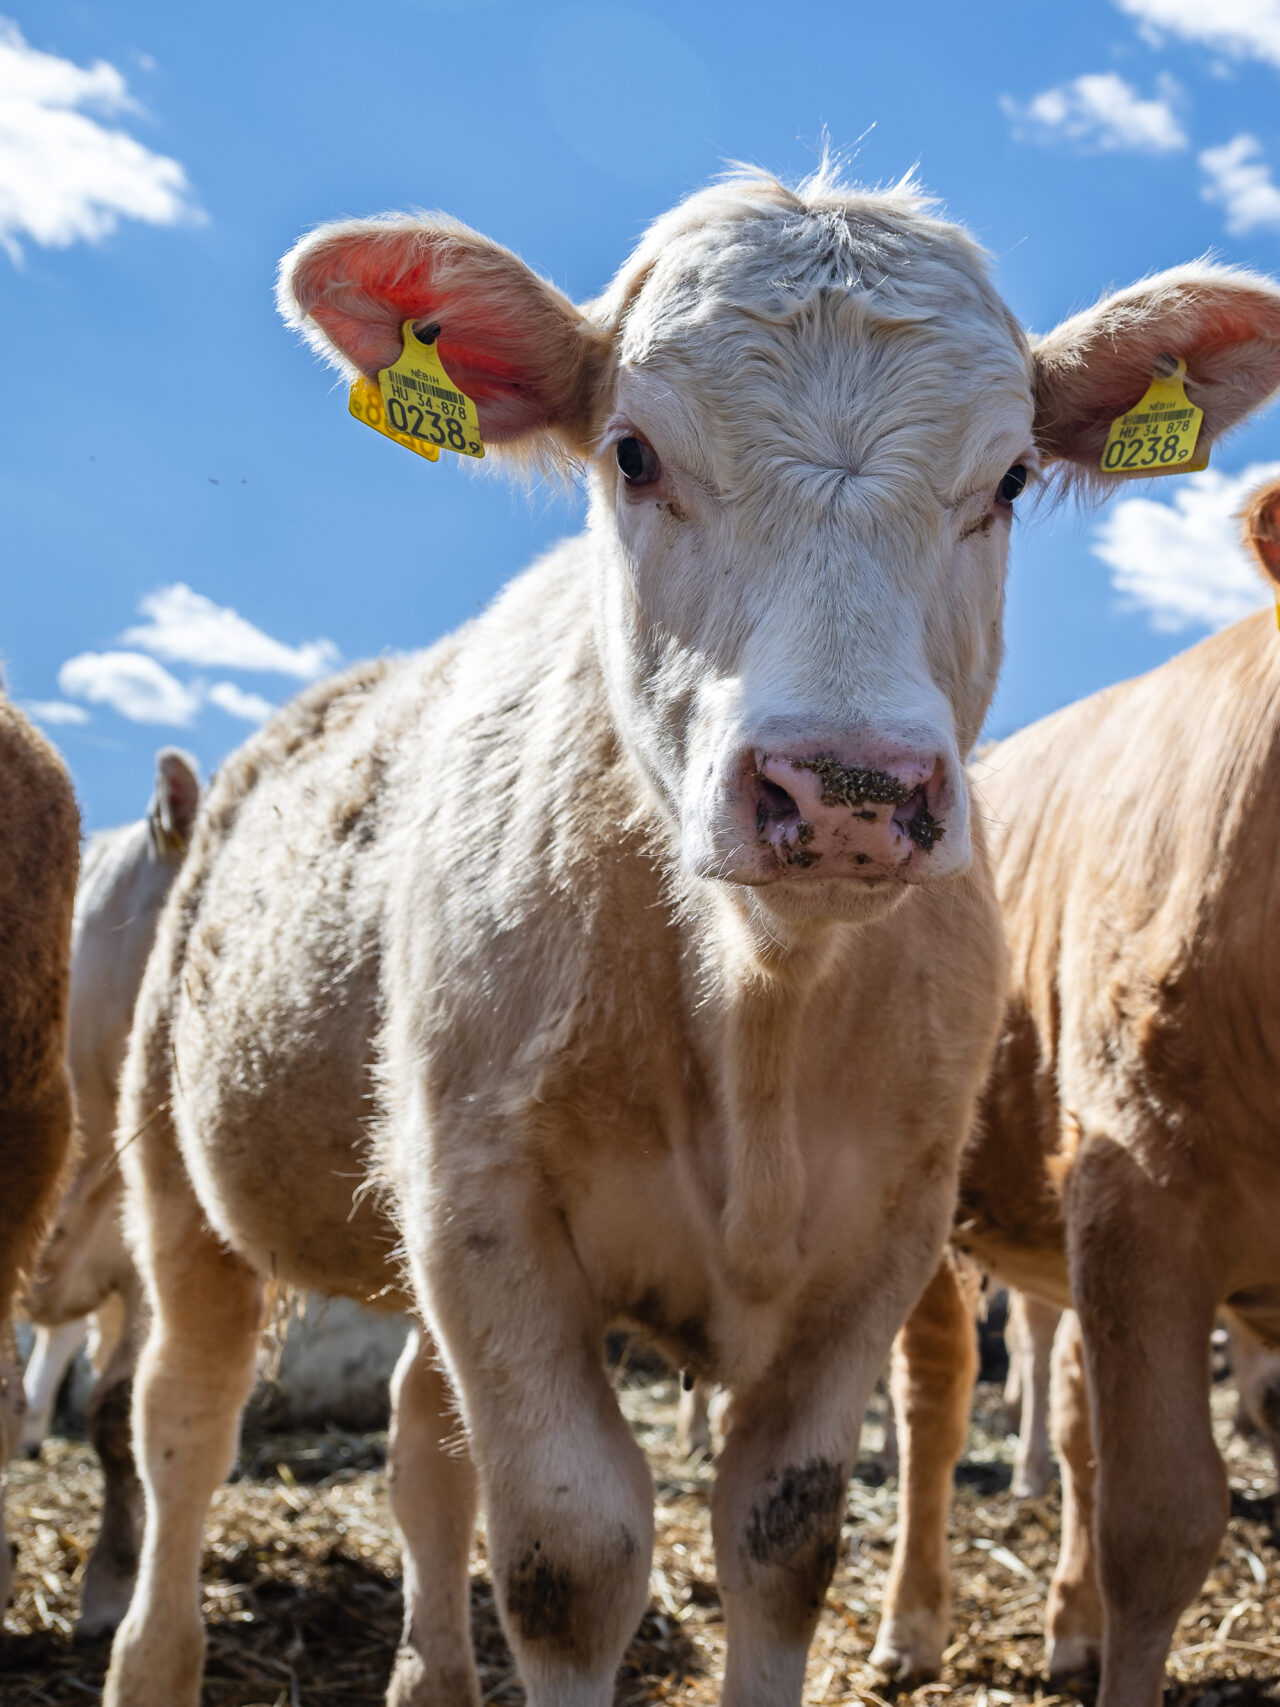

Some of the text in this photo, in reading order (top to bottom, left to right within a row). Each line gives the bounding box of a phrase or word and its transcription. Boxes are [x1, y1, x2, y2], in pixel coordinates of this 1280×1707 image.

[410, 368, 440, 384] NÉBIH
[391, 384, 466, 420] HU 34 878
[1119, 420, 1190, 439] HU 34 878
